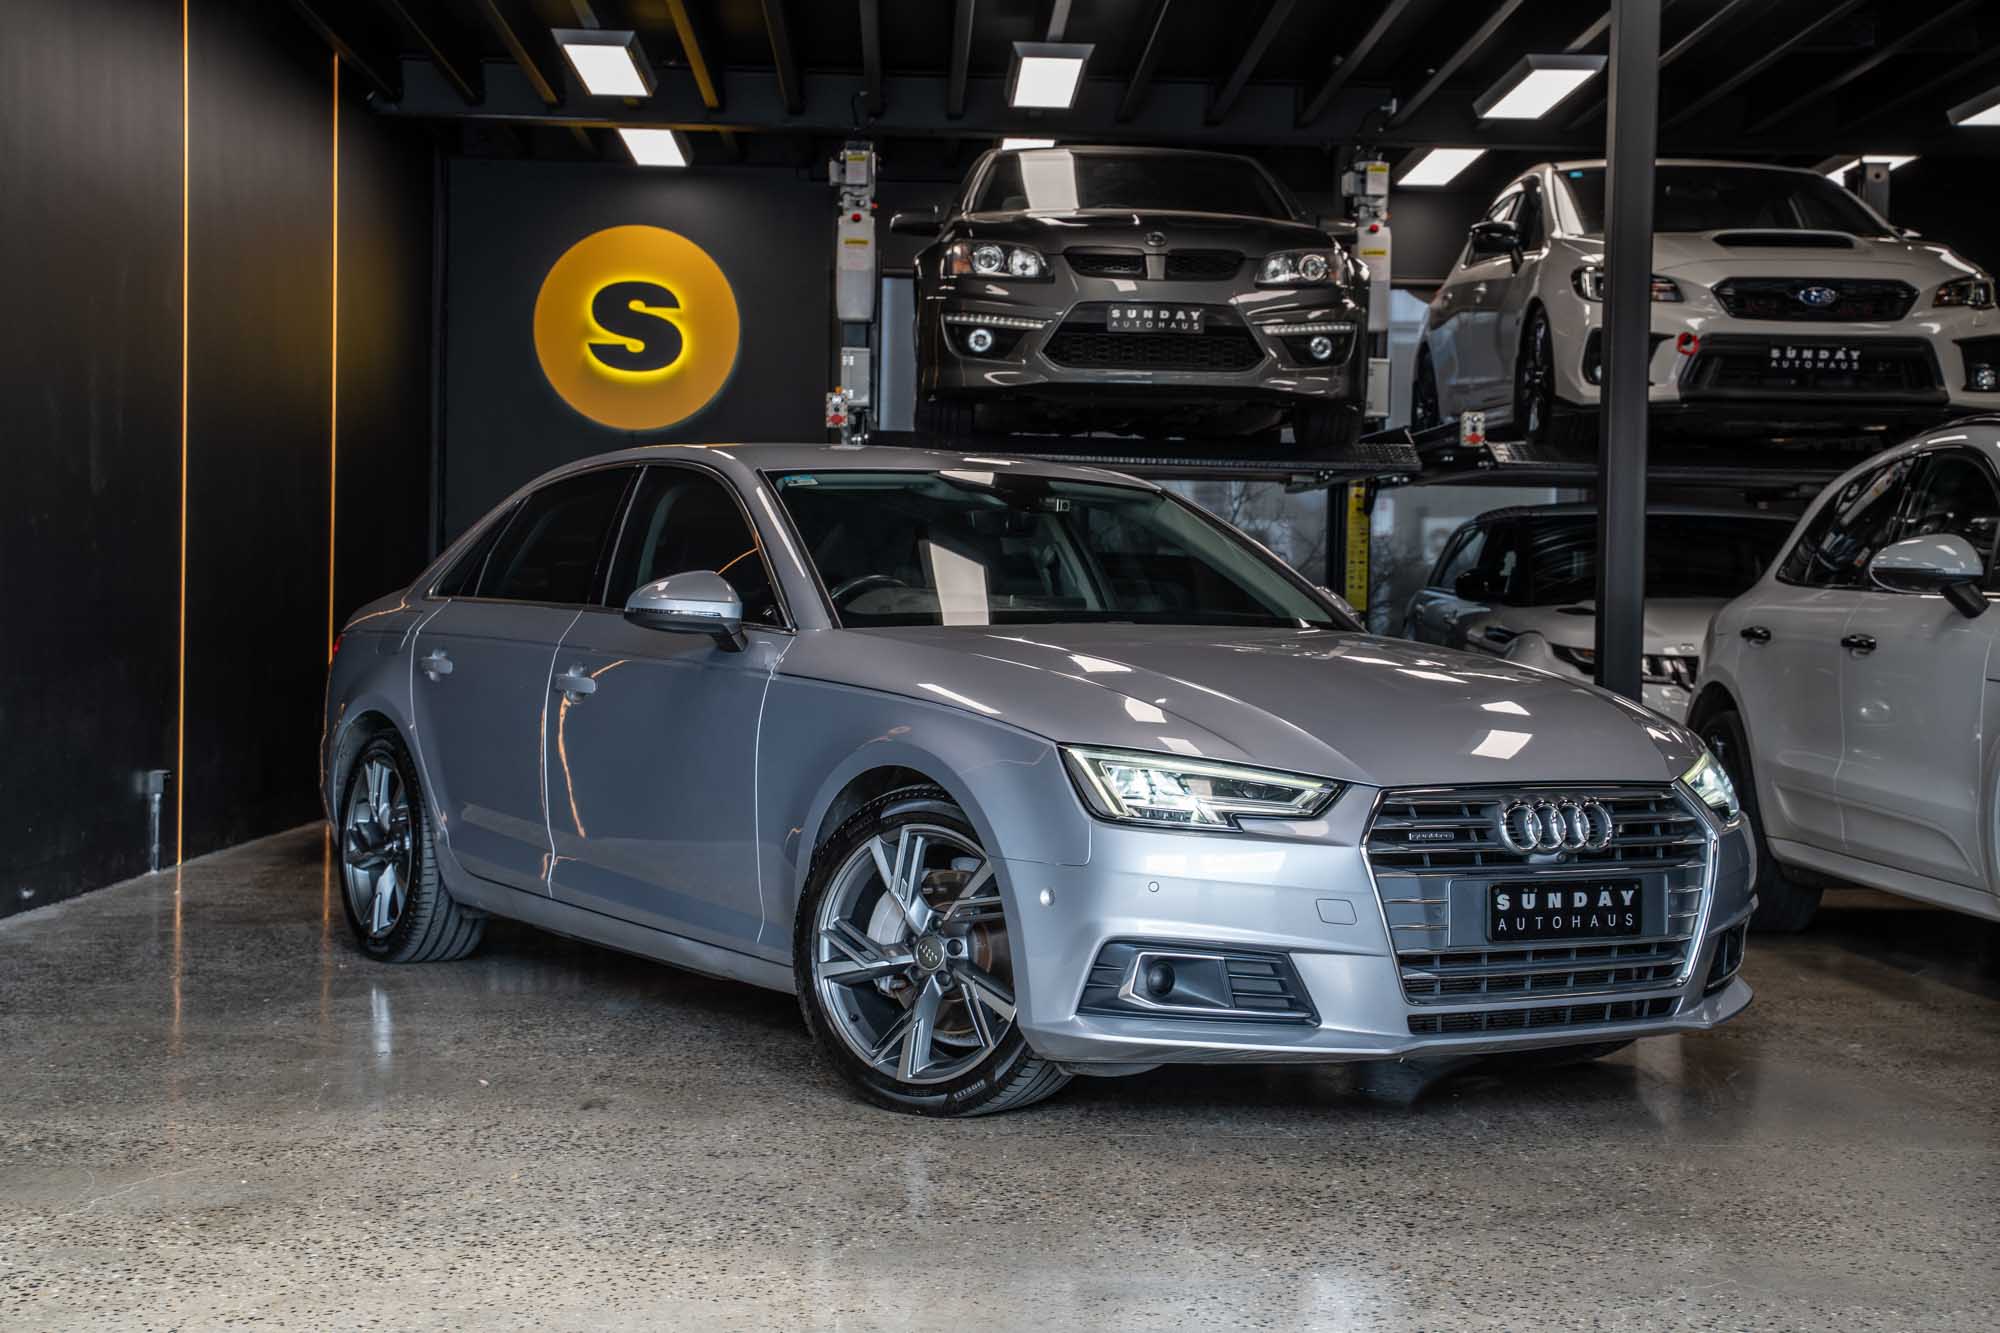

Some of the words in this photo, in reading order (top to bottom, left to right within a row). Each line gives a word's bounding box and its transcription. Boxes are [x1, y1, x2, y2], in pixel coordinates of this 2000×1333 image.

[1111, 308, 1201, 320] SUNDAY
[588, 281, 683, 371] S
[1111, 321, 1200, 330] AUTOHAUS
[1770, 348, 1861, 360] SUNDAY
[1770, 360, 1860, 370] AUTOHAUS
[1496, 889, 1635, 910] SUNDAY
[1497, 913, 1634, 931] AUTOHAUS
